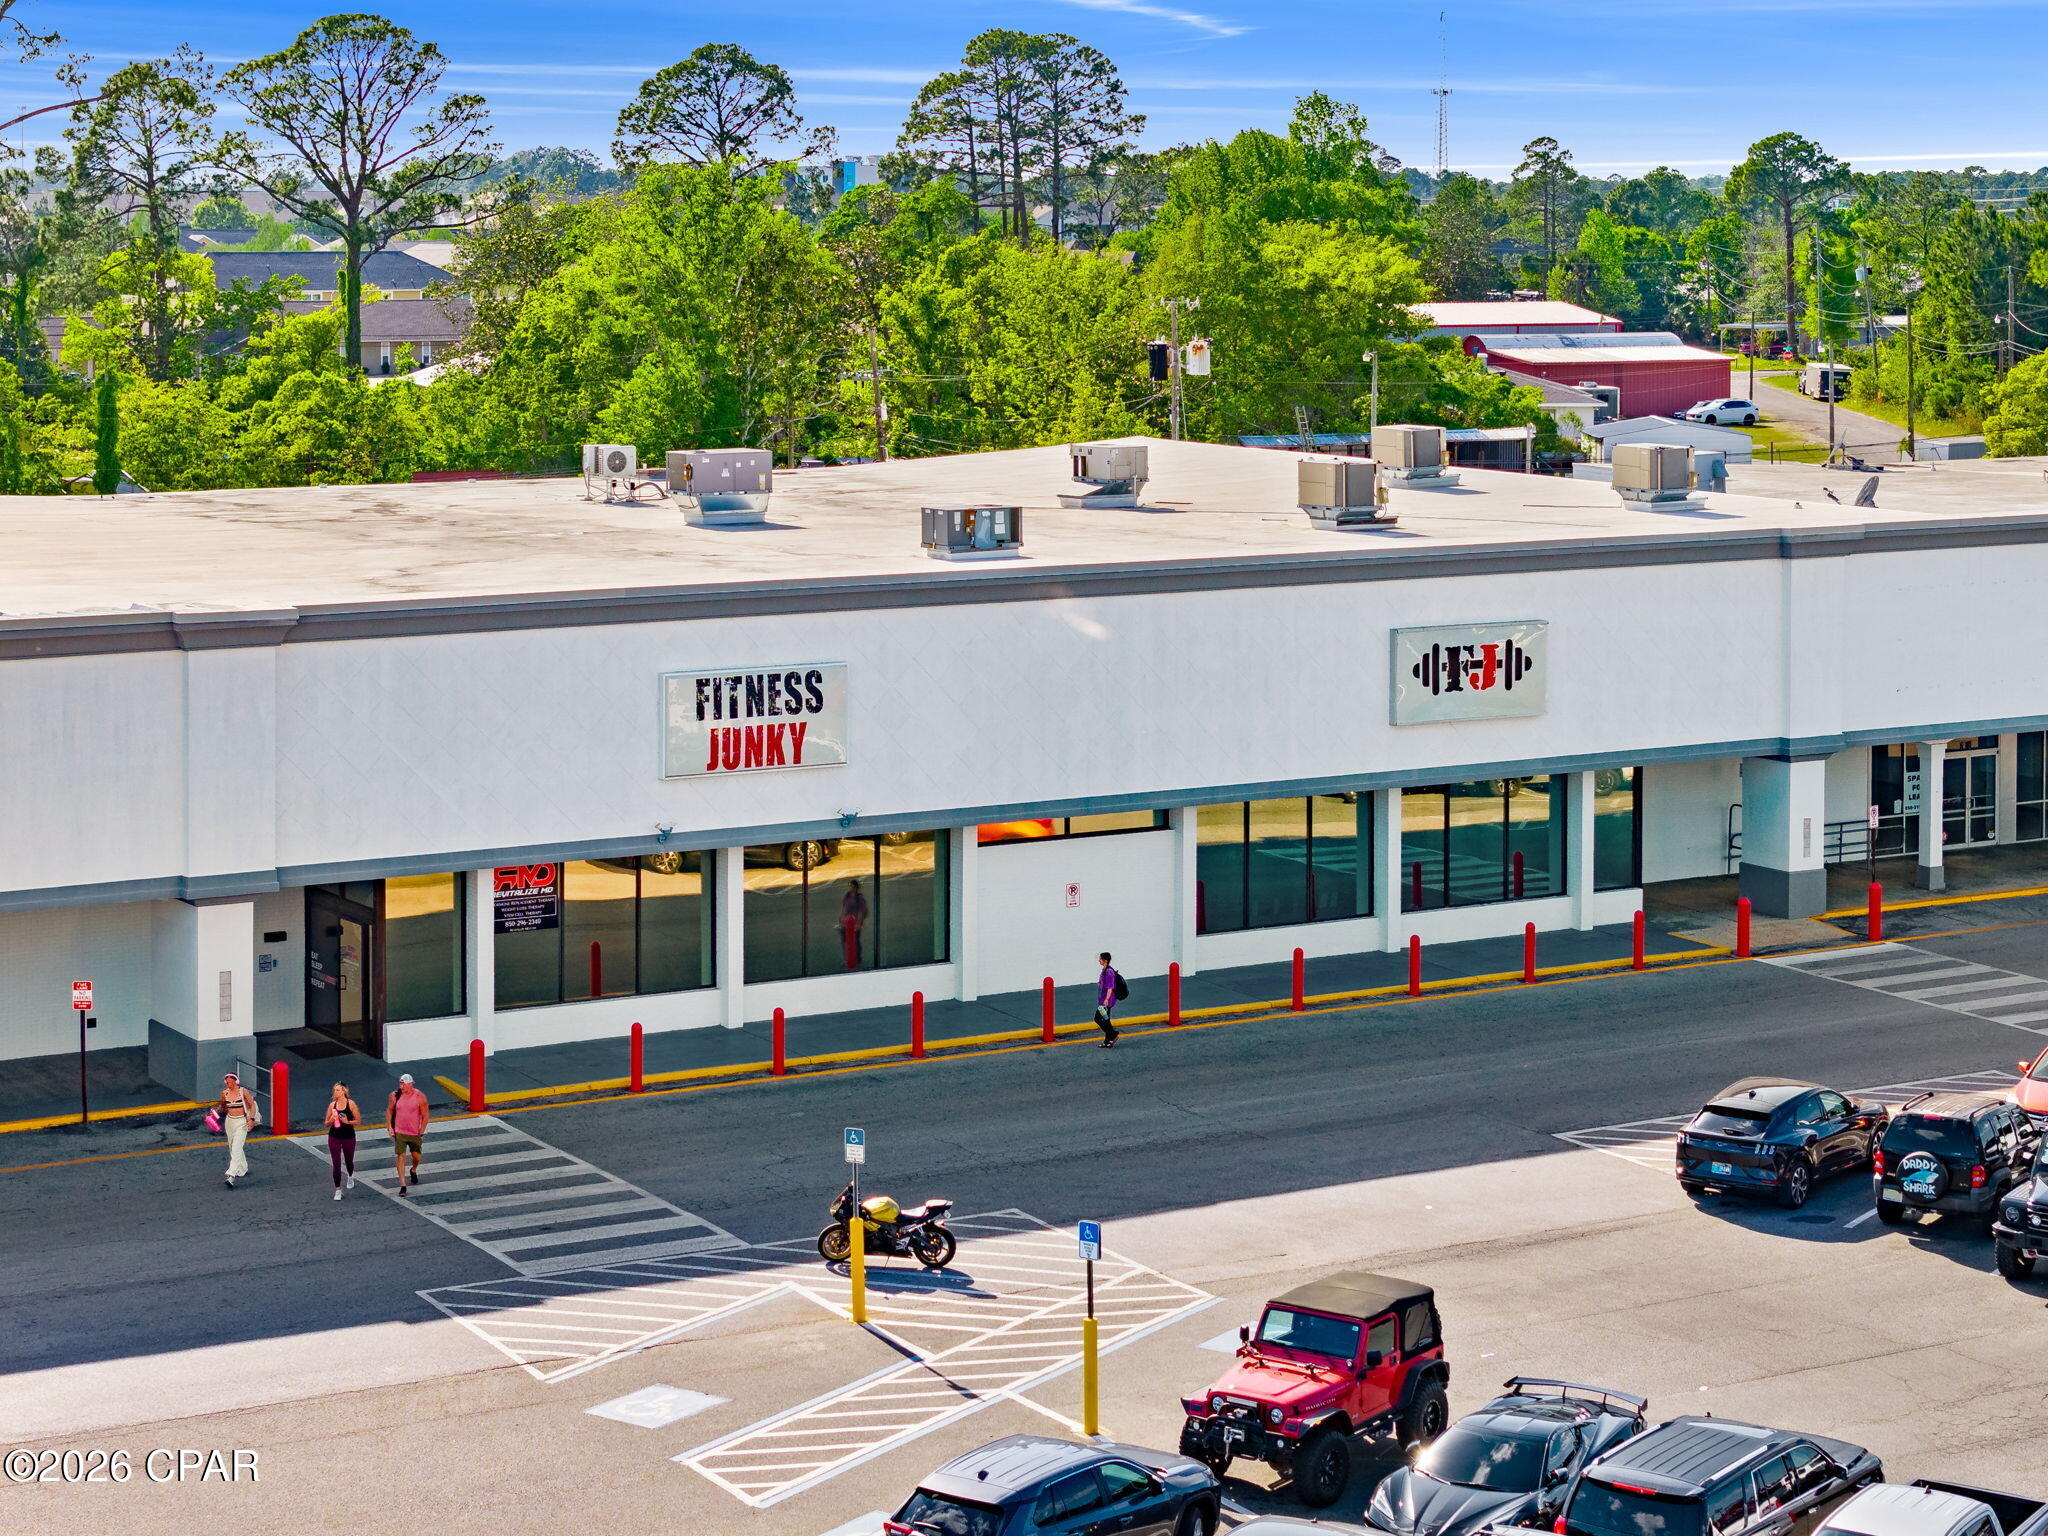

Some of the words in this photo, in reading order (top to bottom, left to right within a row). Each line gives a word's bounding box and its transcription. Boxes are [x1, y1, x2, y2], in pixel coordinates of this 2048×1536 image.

[695, 669, 824, 721] FITNESS
[706, 721, 808, 771] JUNKY
[540, 886, 554, 894] MD
[1902, 1158, 1938, 1172] DADDY
[1903, 1180, 1936, 1195] SHARK
[1305, 1397, 1336, 1411] RUBICON
